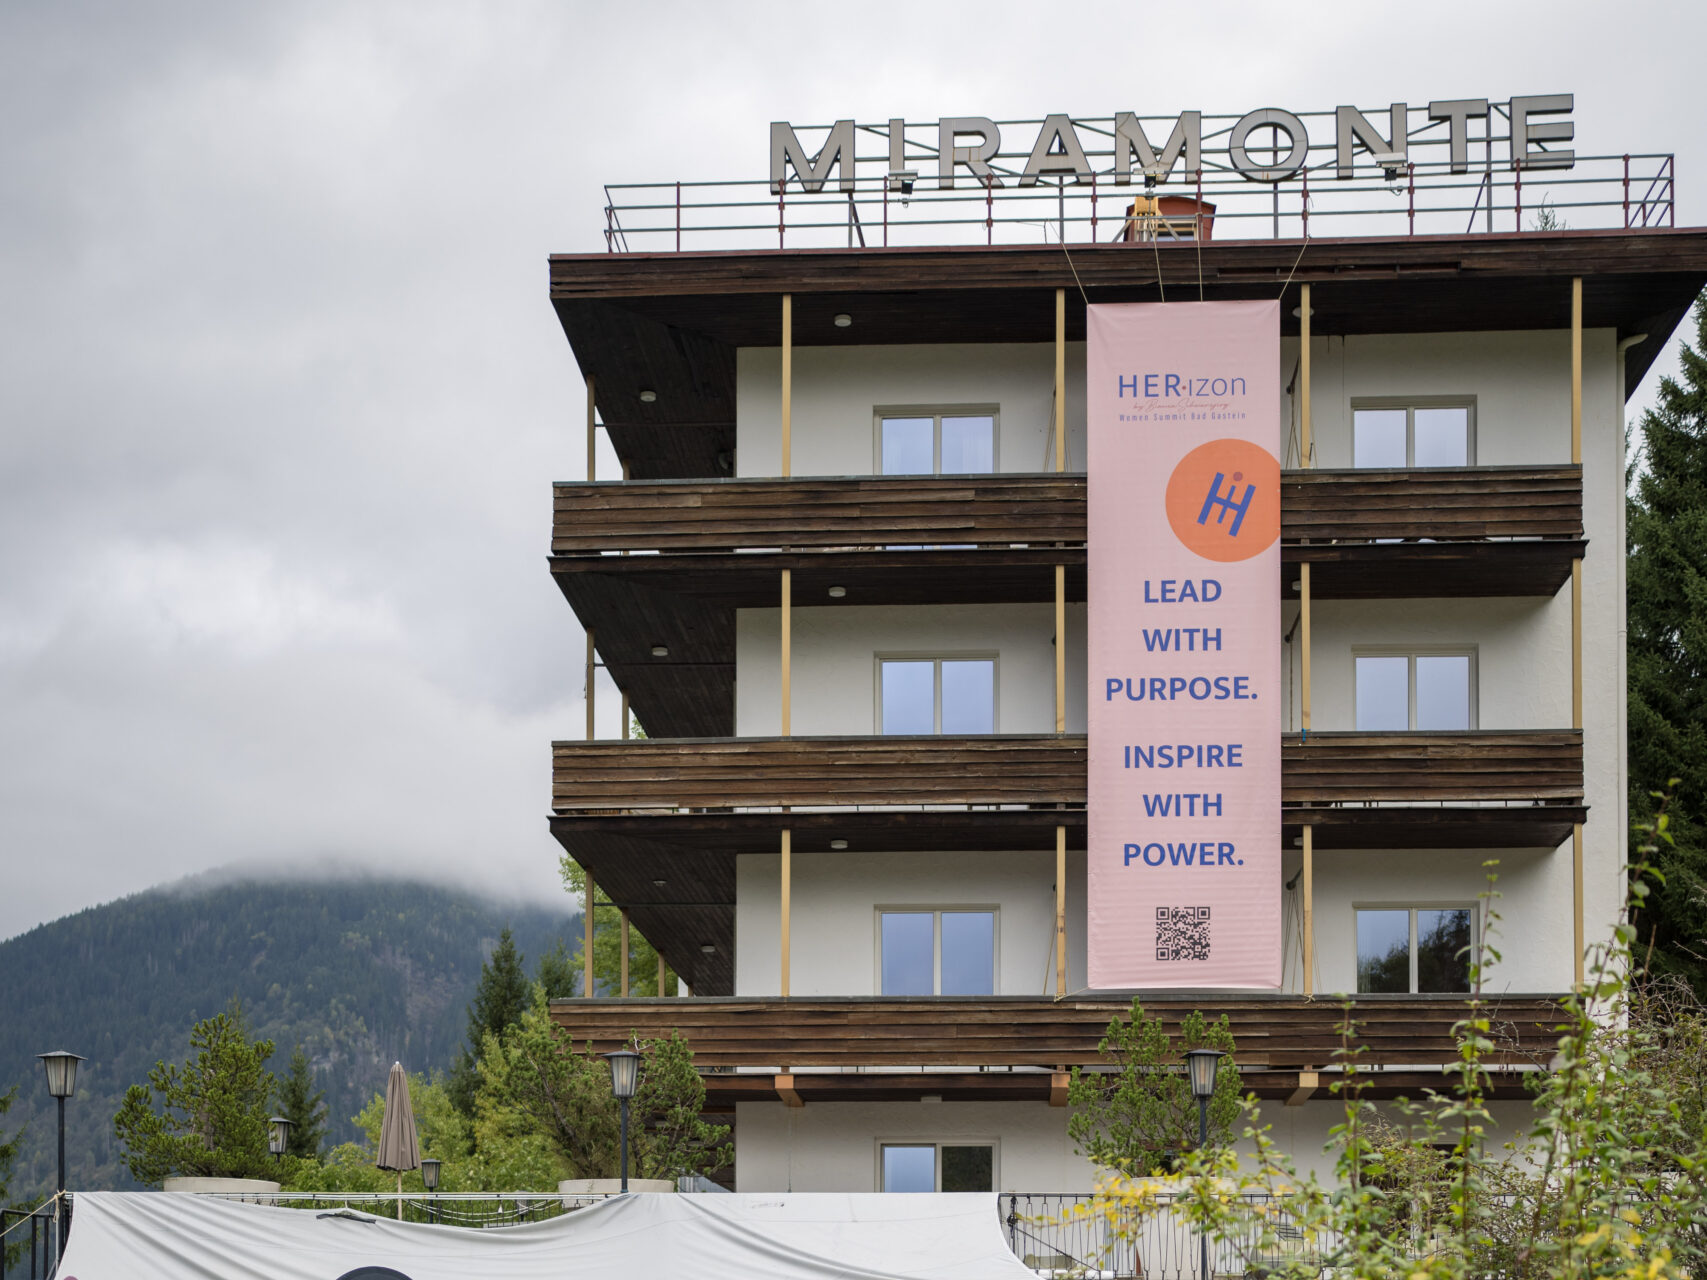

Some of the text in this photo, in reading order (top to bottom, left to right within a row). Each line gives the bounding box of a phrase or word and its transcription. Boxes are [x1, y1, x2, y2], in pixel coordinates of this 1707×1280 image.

[770, 93, 1575, 195] MIRAMONTE
[1153, 413, 1186, 421] Summit
[1191, 412, 1207, 420] Bad
[1143, 579, 1223, 604] LEAD
[1142, 627, 1223, 652] WITH
[1106, 676, 1258, 701] PURPOSE.
[1124, 744, 1243, 768] INSPIRE
[1142, 793, 1223, 817] WITH
[1123, 842, 1244, 867] POWER.
